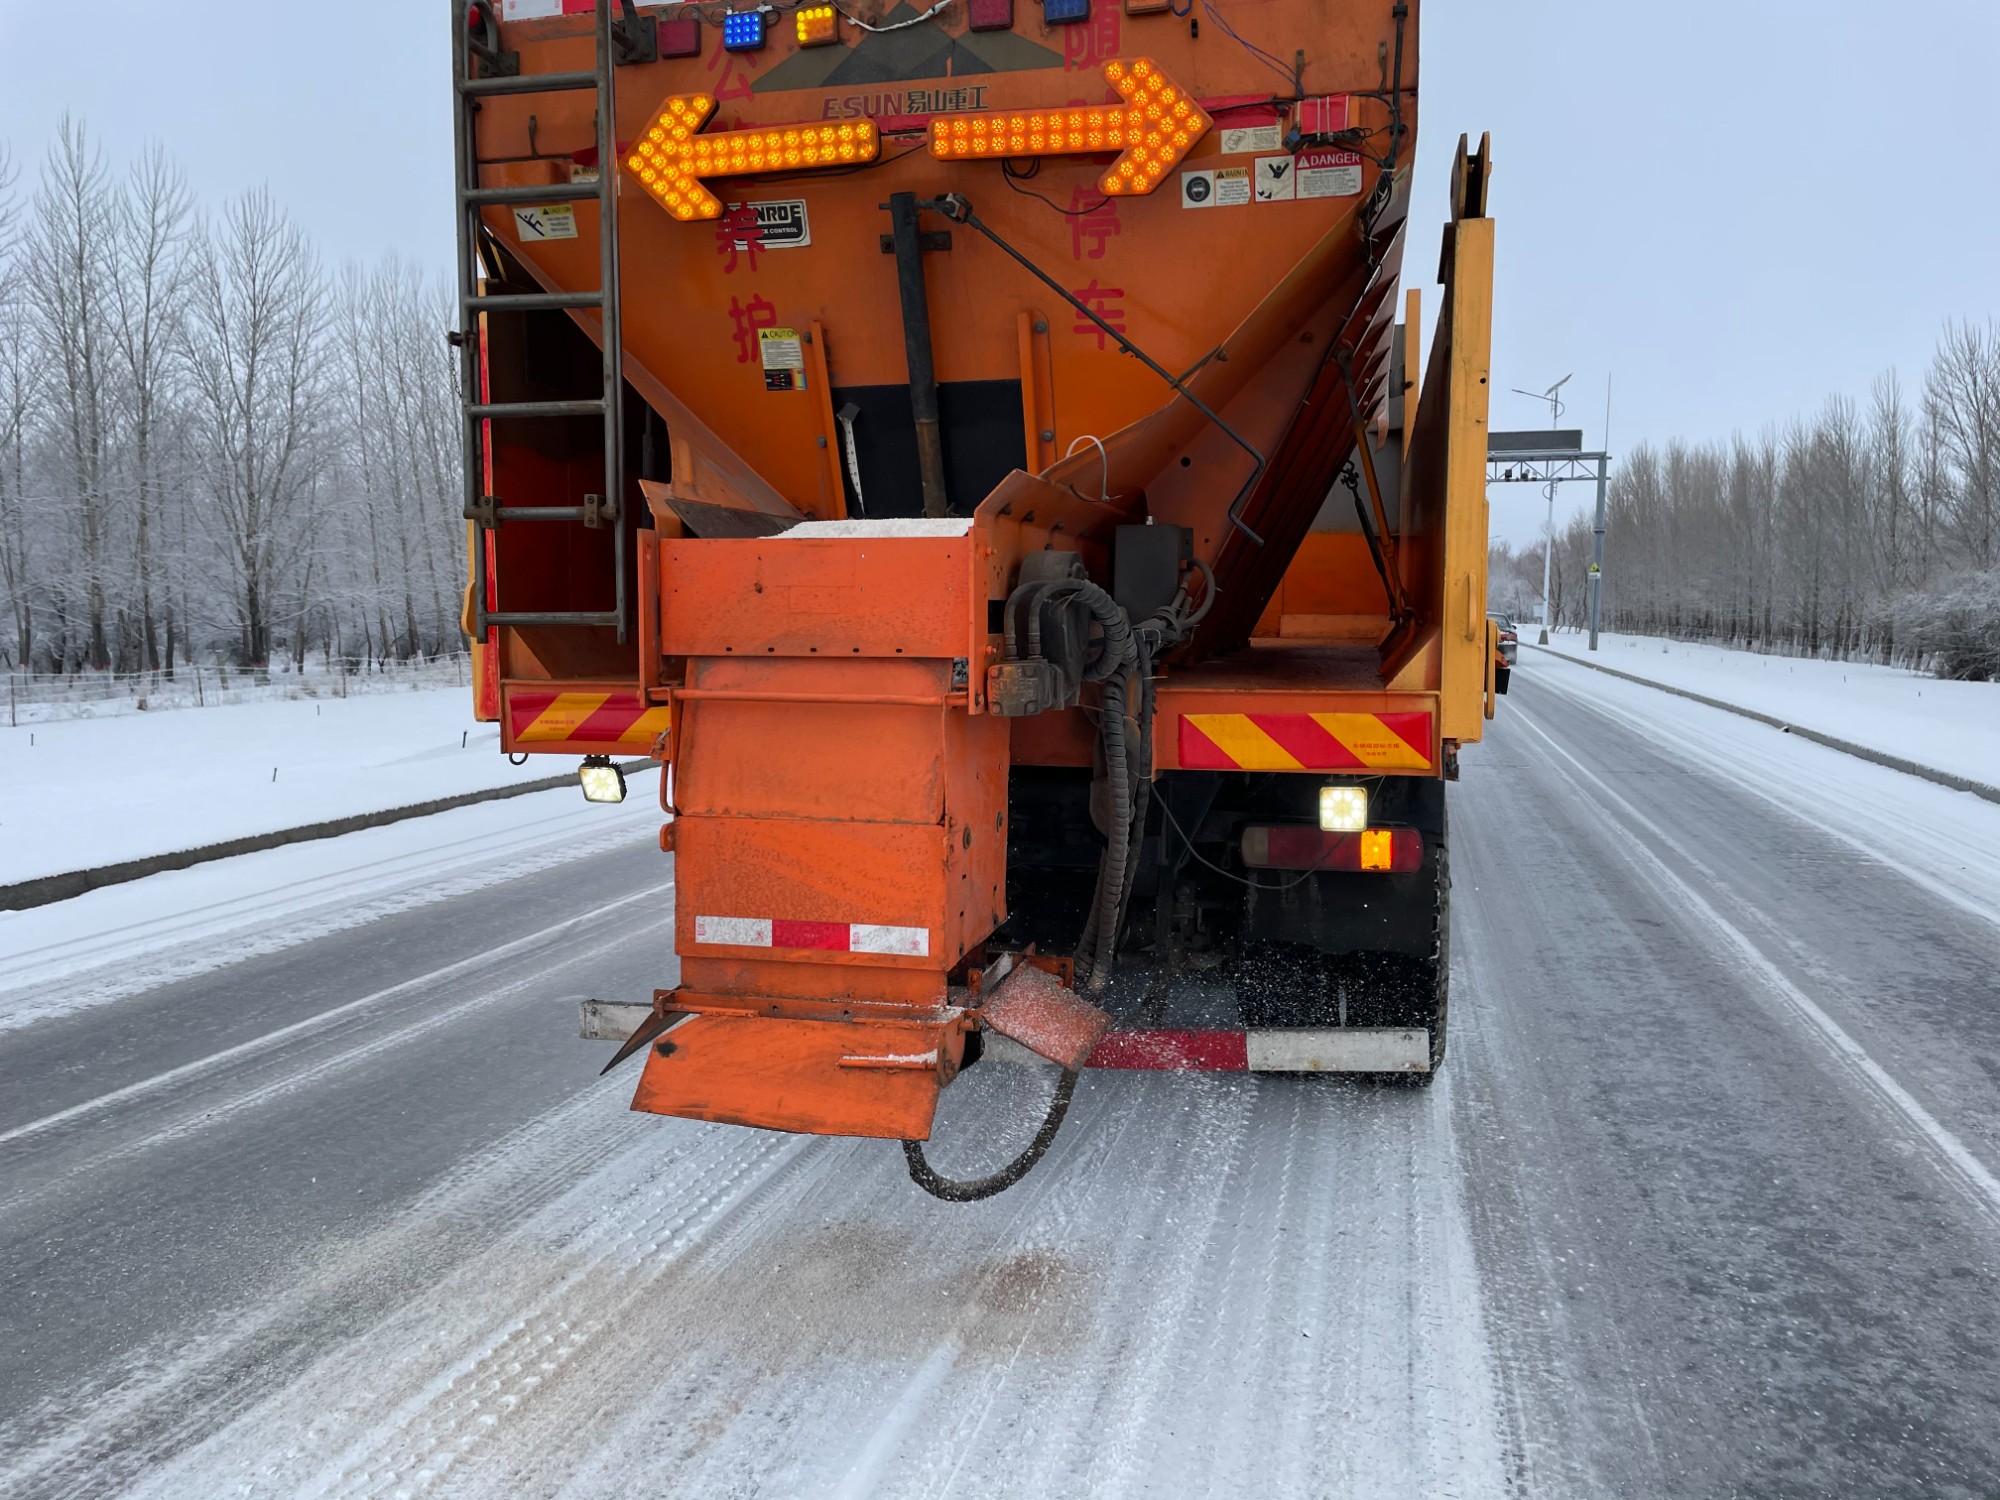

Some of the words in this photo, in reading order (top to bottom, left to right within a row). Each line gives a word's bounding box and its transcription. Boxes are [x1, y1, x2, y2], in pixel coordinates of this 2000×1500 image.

[821, 93, 902, 120] ESUN
[907, 86, 989, 114] 易山重工
[1064, 0, 1126, 350] 随停车
[1310, 153, 1360, 167] DANGER
[705, 35, 777, 363] 公养护
